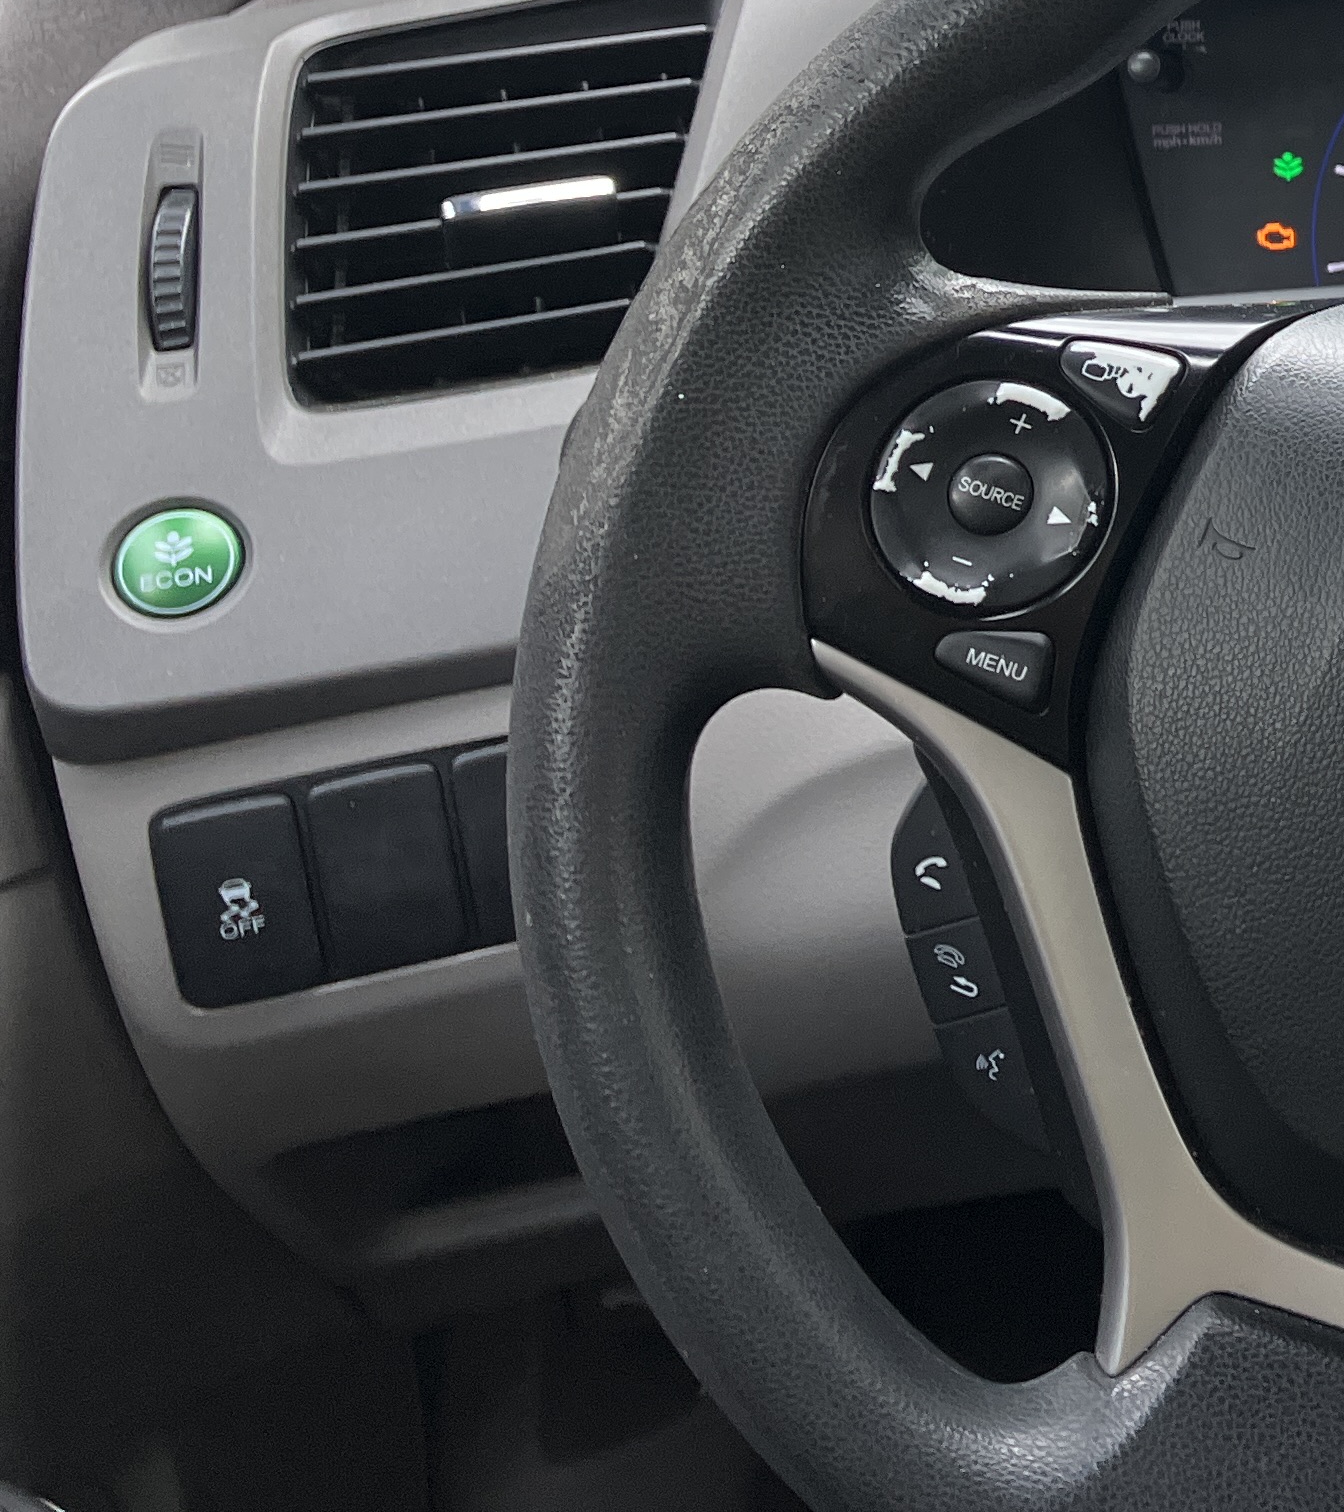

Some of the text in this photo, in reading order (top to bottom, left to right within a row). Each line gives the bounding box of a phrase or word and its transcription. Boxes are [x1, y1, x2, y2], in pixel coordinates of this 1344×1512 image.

[958, 476, 1024, 510] SOURCE
[139, 564, 214, 594] ECON
[966, 648, 1028, 681] MENU
[219, 914, 266, 941] OFF
